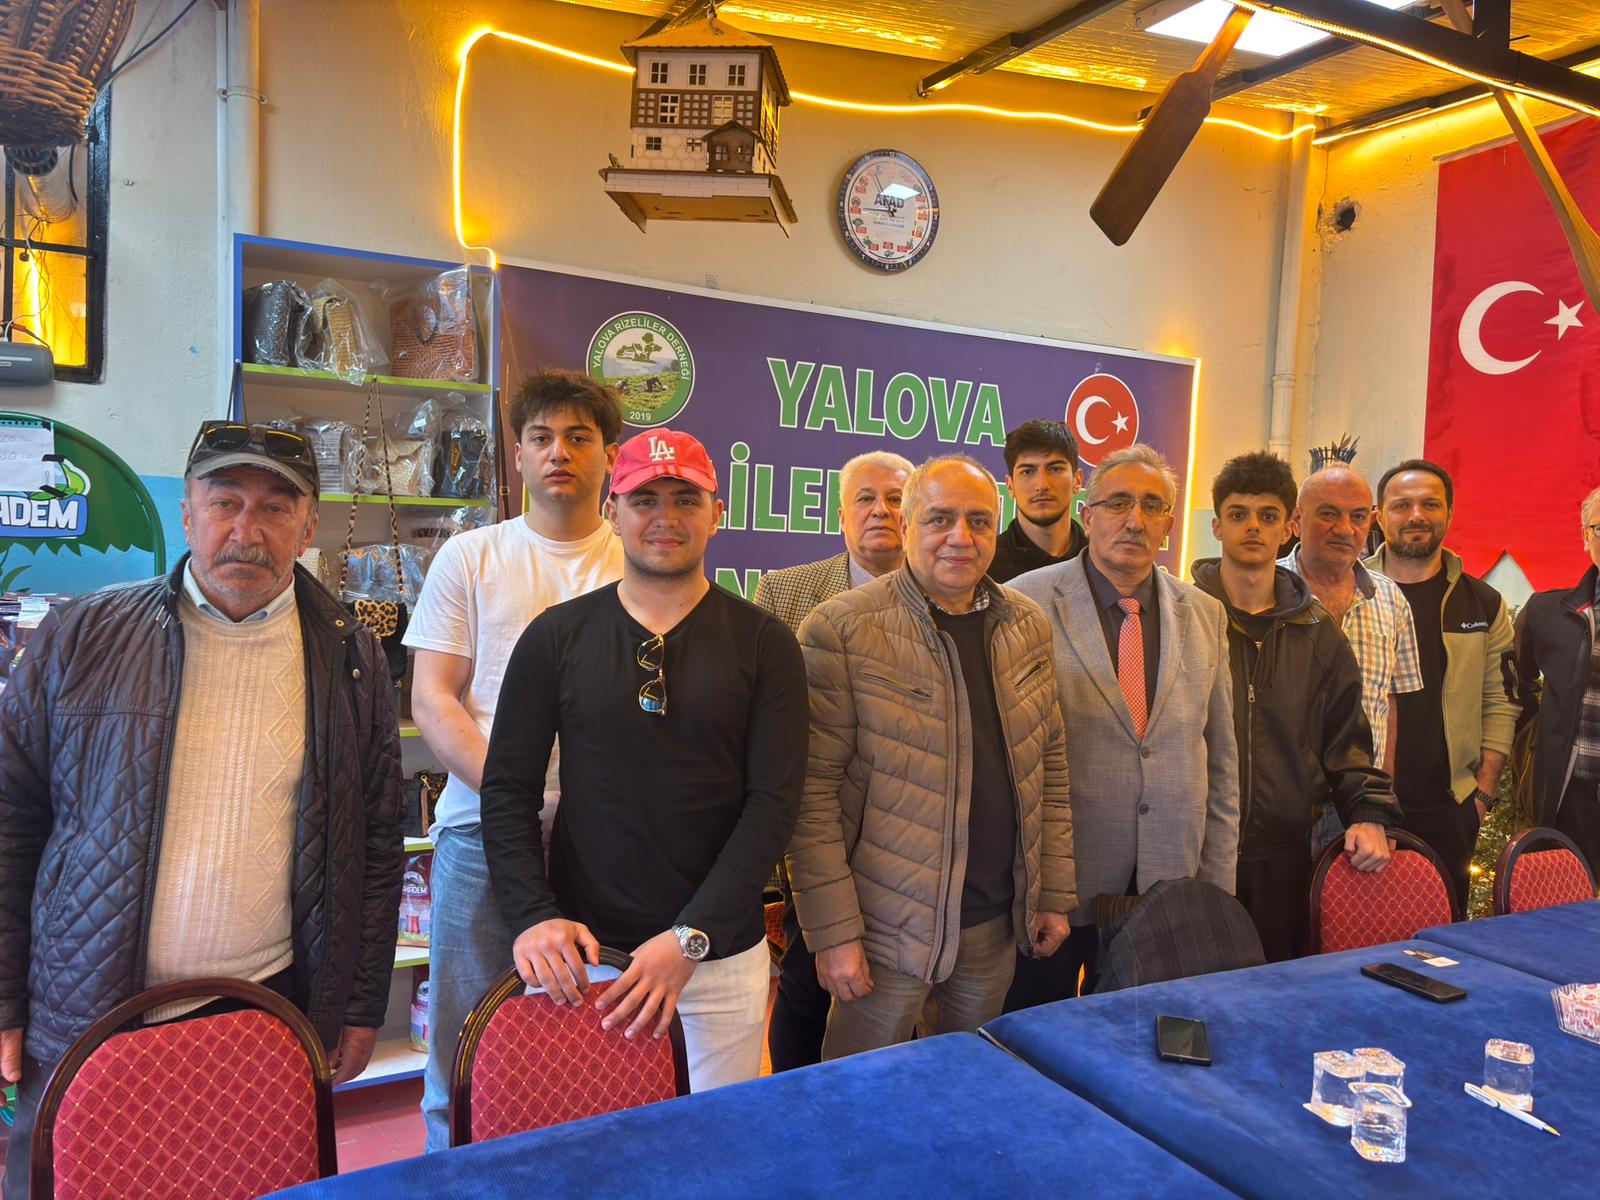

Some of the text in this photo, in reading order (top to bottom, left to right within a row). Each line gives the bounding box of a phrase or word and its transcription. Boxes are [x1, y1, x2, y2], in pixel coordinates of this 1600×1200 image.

[593, 329, 616, 369] YALOVA
[614, 318, 666, 335] RİZELİLER
[629, 410, 652, 422] 2019
[766, 356, 1007, 448] YALOVA
[648, 436, 676, 462] LA
